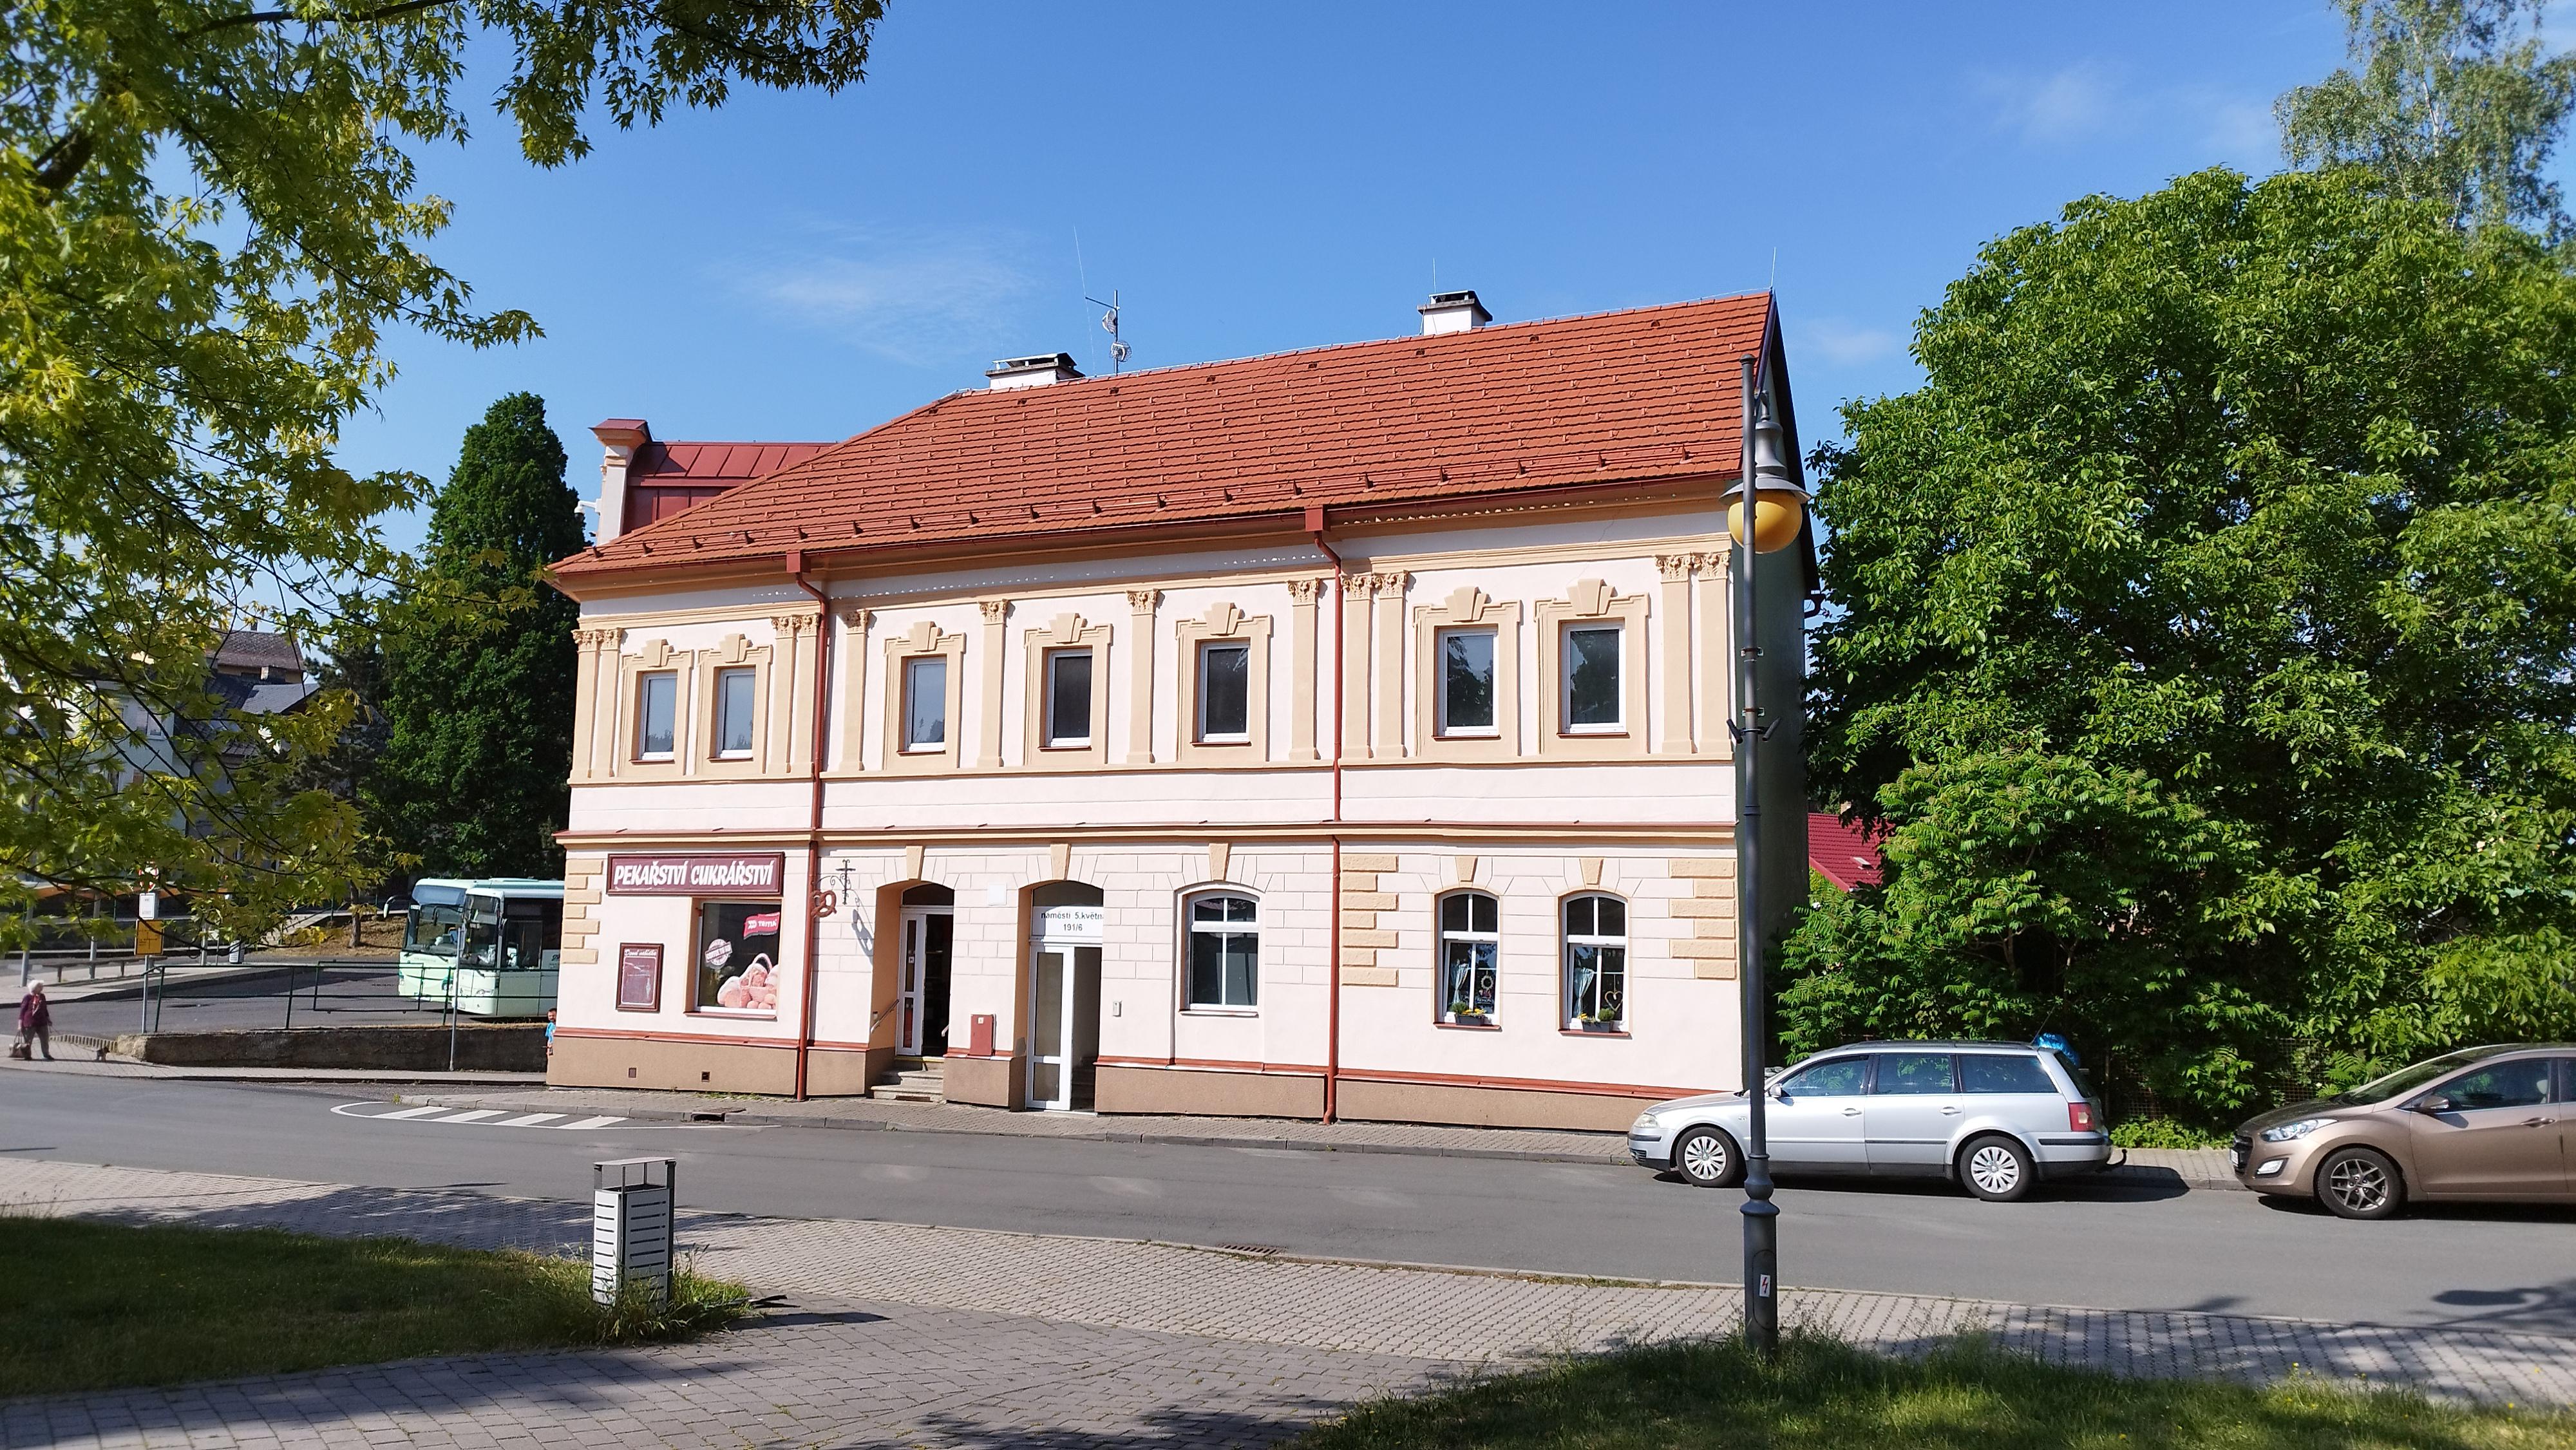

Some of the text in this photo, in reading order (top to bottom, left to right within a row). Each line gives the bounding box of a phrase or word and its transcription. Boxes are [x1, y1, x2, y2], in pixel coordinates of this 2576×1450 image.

[613, 860, 774, 887] PEKAŘSTVÍ CUKRÁŘSTVÍ
[1063, 923, 1083, 932] 191/6
